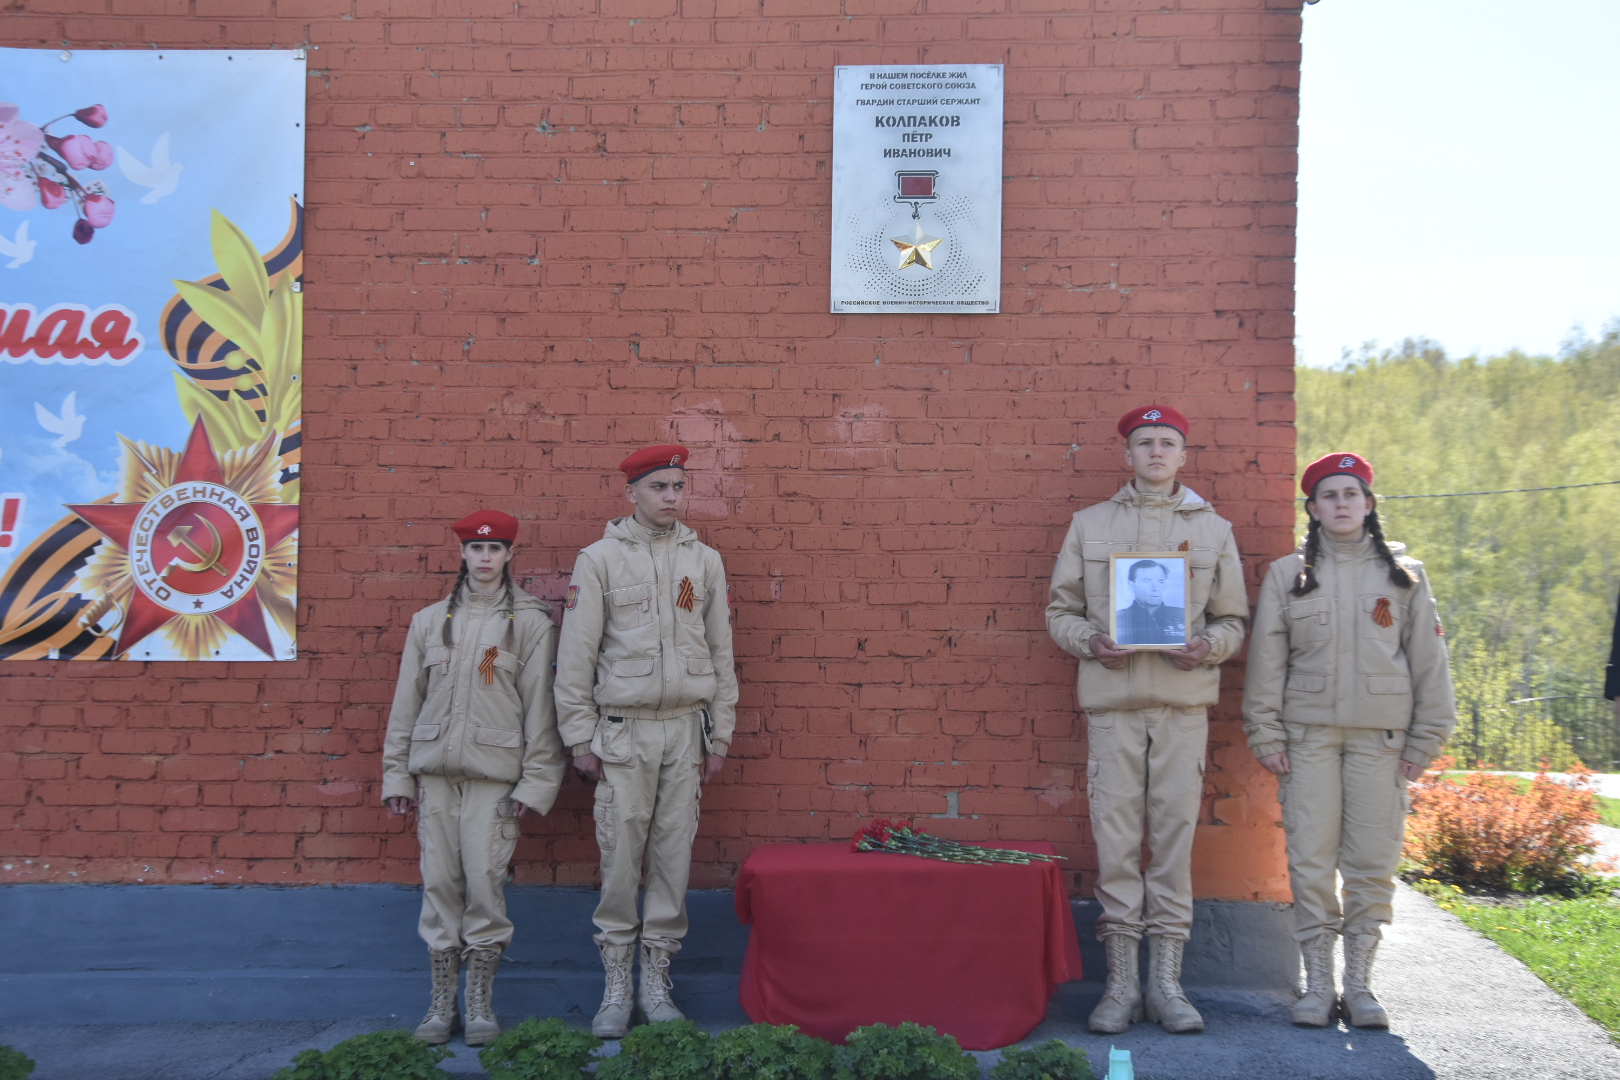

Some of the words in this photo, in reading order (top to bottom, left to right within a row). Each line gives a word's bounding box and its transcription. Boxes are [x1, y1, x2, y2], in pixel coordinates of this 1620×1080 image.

[910, 70, 947, 79] ПОСЁЛКЕ
[860, 82, 888, 90] ГЕРОЙ
[856, 98, 894, 106] ГВАРДИИ
[896, 97, 938, 106] СТАРШИЙ
[875, 115, 961, 128] КОЛПАКОВ
[902, 130, 933, 142] ПЁТР
[883, 148, 951, 158] ИВАНОВИЧ
[136, 486, 251, 601] ОТЕЧЕСТВЕННАЯ
